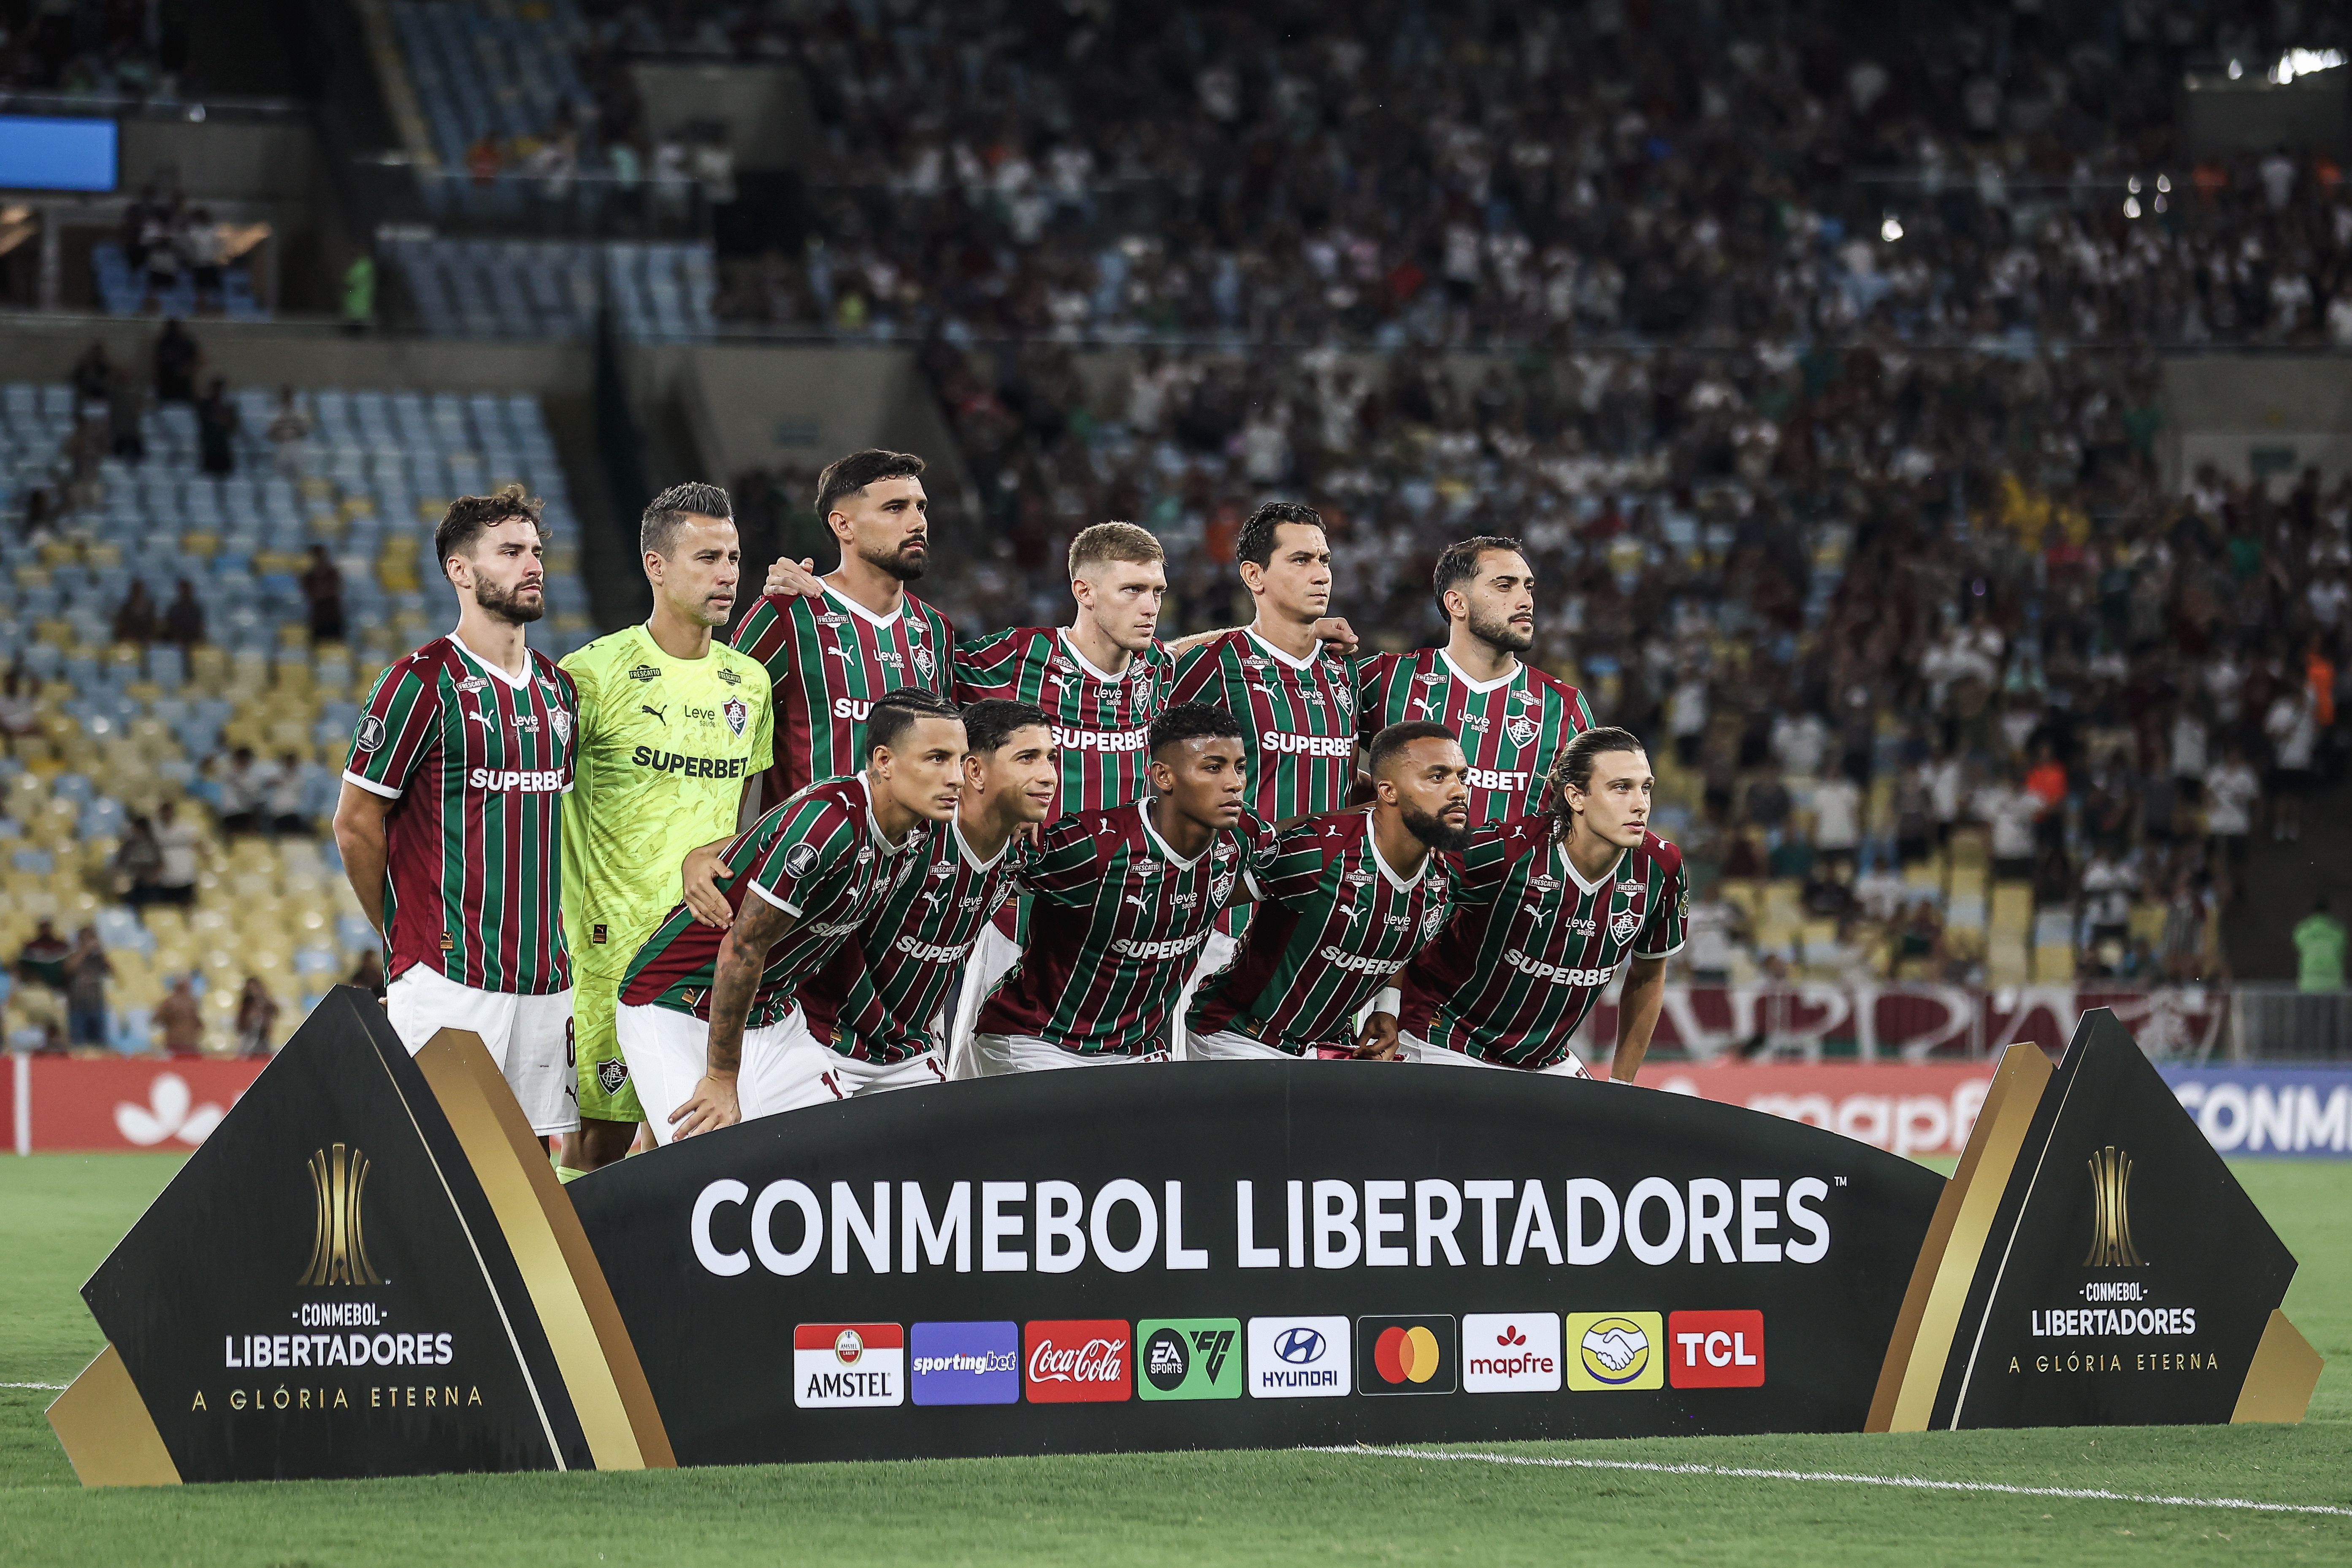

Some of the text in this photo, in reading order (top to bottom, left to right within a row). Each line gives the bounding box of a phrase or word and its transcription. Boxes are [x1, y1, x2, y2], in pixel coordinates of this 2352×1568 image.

[873, 649, 902, 661] Leve
[630, 669, 660, 678] FRESCATTO
[719, 672, 740, 682] FRESCATTO
[459, 680, 486, 689] FRESCATTO
[1093, 686, 1122, 699] Leve
[1294, 688, 1323, 699] Leve
[1513, 692, 1540, 705] FRESCATTO
[510, 714, 538, 727] Leve
[685, 705, 715, 720] Leve
[1457, 709, 1490, 726] Leve
[1052, 726, 1150, 752] SUPERBET
[633, 746, 748, 778] SUPERBET
[470, 767, 565, 792] SUPERBE
[1467, 767, 1528, 791] RBET
[1214, 847, 1234, 858] FRESCATTO
[1347, 874, 1372, 882] FRESCATTO
[1531, 878, 1559, 888] FRESCATTO
[959, 896, 982, 907] Leve
[1170, 893, 1197, 905] Leve
[1383, 913, 1411, 925] Leve
[1565, 917, 1596, 930] Leve
[896, 936, 973, 963] SUPERB
[1321, 946, 1410, 975] SUPERB
[1747, 1078, 1992, 1160] mapf
[2173, 1081, 2352, 1152] ONM
[690, 1178, 1208, 1276] CONMEBOL
[1237, 1176, 1830, 1269] LIBERTADORES
[2086, 1282, 2143, 1301] CONMEBOL
[301, 1302, 379, 1327] CONMEBOL
[2032, 1308, 2195, 1336] LIBERTADORES
[225, 1332, 453, 1368] LIBERTADORES
[1151, 1341, 1181, 1363] EA
[1676, 1331, 1756, 1367] TCL
[913, 1350, 1017, 1375] sportingbet
[1151, 1363, 1183, 1374] SPORTS
[1470, 1353, 1553, 1378] mapfre
[2009, 1351, 2218, 1373] A GLÓRIA ETERNA
[807, 1372, 892, 1398] AMSTEL
[1263, 1370, 1337, 1387] HYUNDAI
[192, 1383, 483, 1411] A GLÓRIA ETERNA
